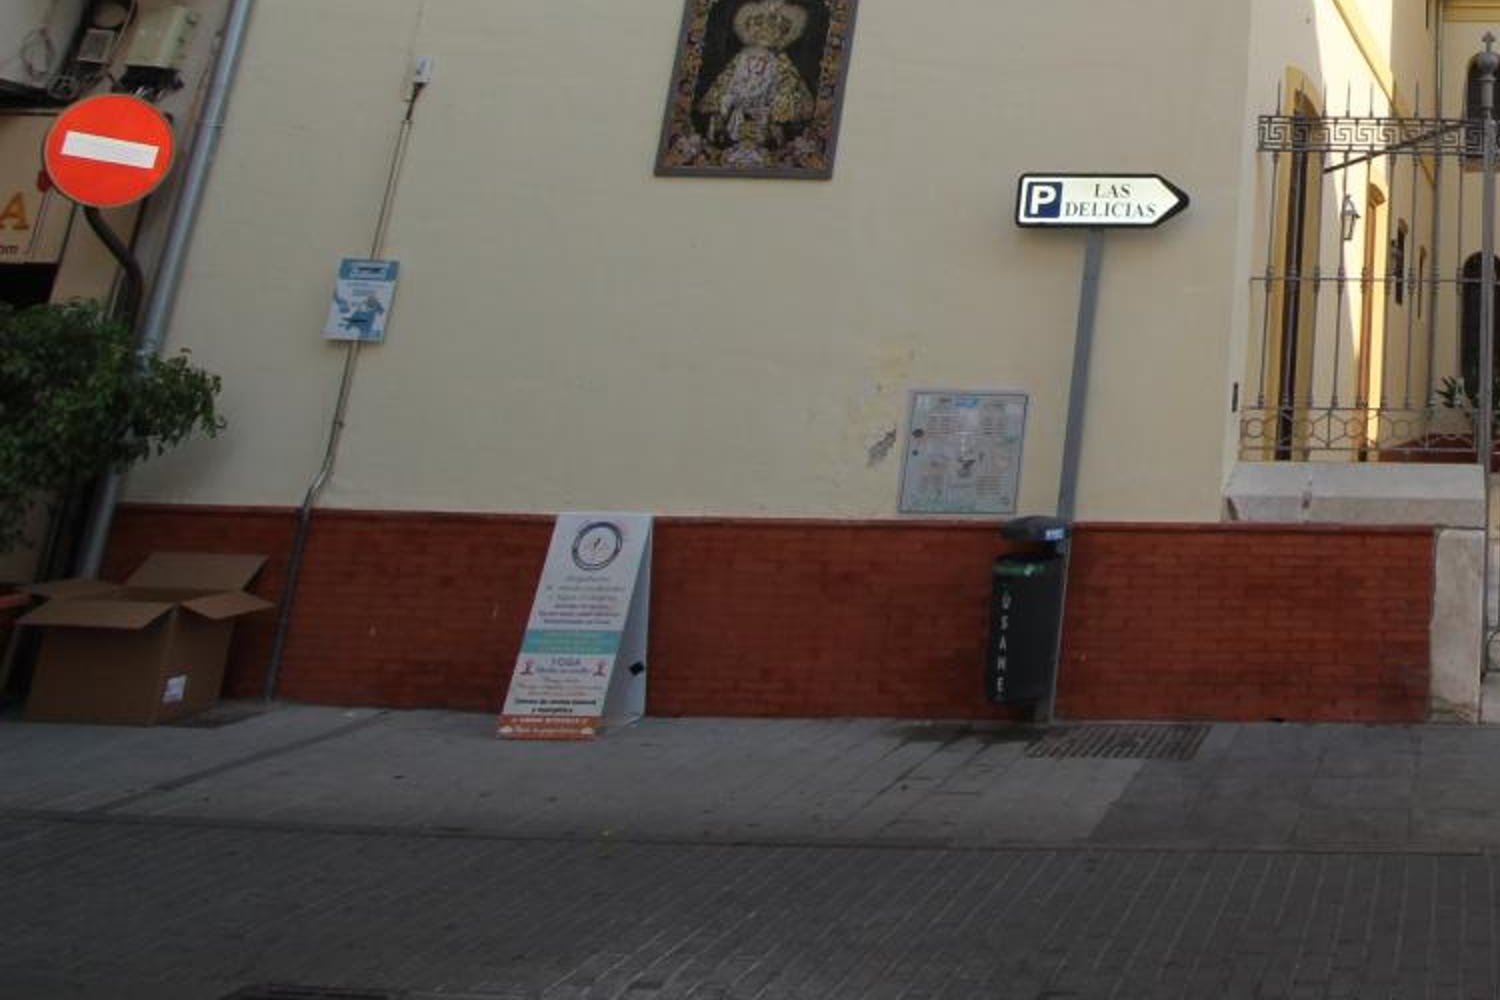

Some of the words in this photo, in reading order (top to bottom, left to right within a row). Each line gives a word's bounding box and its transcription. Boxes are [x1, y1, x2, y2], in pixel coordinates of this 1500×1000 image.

[1095, 183, 1131, 198] LAS
[1030, 185, 1057, 215] P
[1065, 202, 1156, 217] DELICIAS
